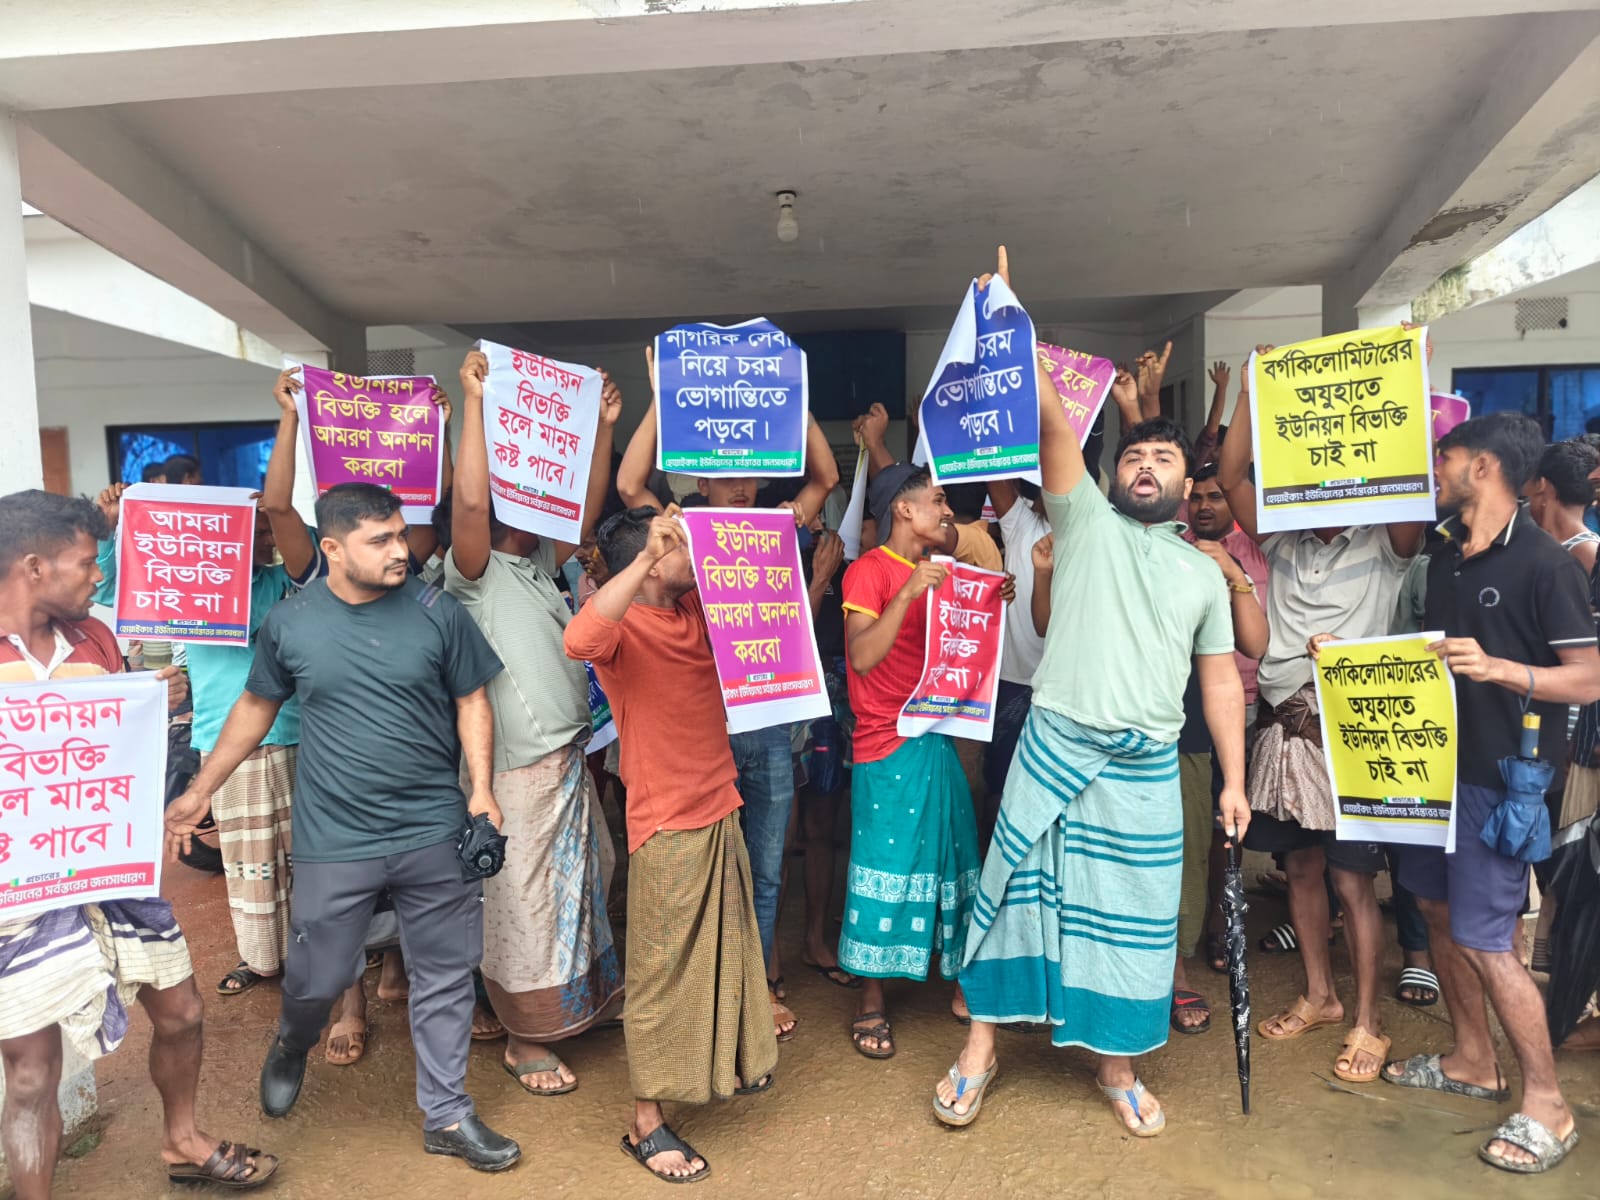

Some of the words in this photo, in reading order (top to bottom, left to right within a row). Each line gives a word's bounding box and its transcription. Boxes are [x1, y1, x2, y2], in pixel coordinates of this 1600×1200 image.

[678, 350, 730, 377] নিয়ে
[734, 356, 783, 377] চরম
[1263, 339, 1413, 381] বর্গকিলোমিটারের
[676, 380, 790, 409] ভোগান্তিতে
[935, 364, 1024, 407] ভোগান্তিতে
[1061, 365, 1098, 398] হলে
[1295, 377, 1383, 410] অযুহাতে
[314, 390, 382, 420] বিভক্তি
[387, 403, 431, 426] হলে
[517, 380, 572, 423] বিভক্তি
[498, 406, 533, 440] হলে
[538, 422, 581, 458] মানুষ
[694, 417, 757, 444] পড়বে
[959, 410, 999, 442] পড়বে
[1275, 411, 1345, 442] ইউনিয়ন
[1351, 401, 1408, 434] বিভক্তি
[312, 425, 372, 448] আমরণ
[376, 431, 435, 453] অনশন
[1308, 439, 1347, 467] চাই
[1351, 439, 1378, 462] না
[341, 456, 406, 479] করবো
[493, 440, 521, 468] কষ্ট
[527, 455, 566, 487] পাবে
[148, 511, 232, 533] আমরা
[711, 519, 782, 555] ইউনিয়ন
[133, 531, 245, 560] ইউনিয়ন
[144, 559, 234, 585] বিভক্তি
[702, 555, 760, 592] বিভক্তি
[764, 566, 793, 593] হলে
[132, 587, 185, 613] চাই
[191, 592, 224, 613] না
[705, 601, 754, 630] আমরণ
[758, 600, 801, 627] অনশন
[731, 636, 782, 665] করবো
[946, 666, 970, 688] না
[1322, 655, 1440, 687] বর্গকিলোমিটারের
[0, 693, 126, 740] উনিয়ন
[1347, 694, 1415, 724] অযুহাতে
[1338, 721, 1391, 751] ইউনিয়ন
[1392, 720, 1448, 751] বিভক্তি
[1366, 754, 1402, 784] চাই
[1402, 757, 1429, 783] না
[45, 775, 136, 813] মানুষ
[29, 822, 113, 858] পাবে
[45, 880, 87, 896] সর্বস্তরের
[90, 872, 147, 888] জনসাধারণ
